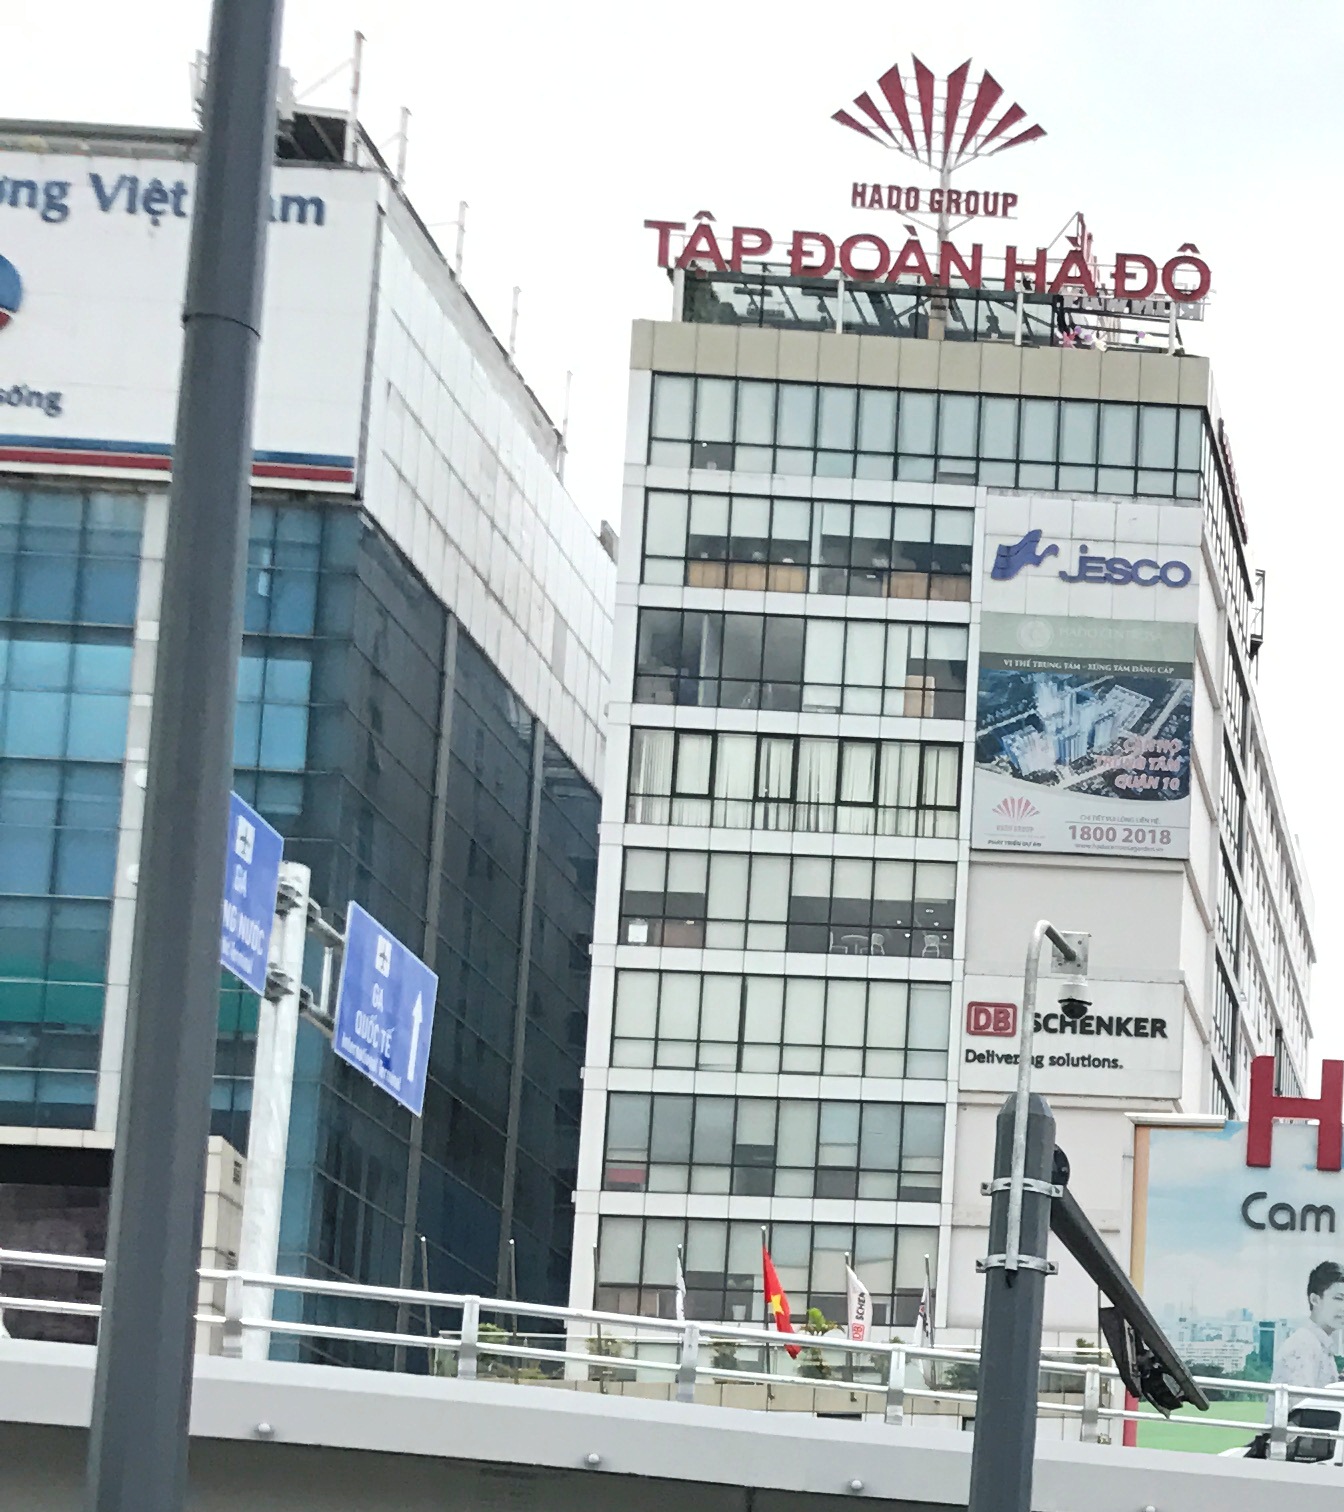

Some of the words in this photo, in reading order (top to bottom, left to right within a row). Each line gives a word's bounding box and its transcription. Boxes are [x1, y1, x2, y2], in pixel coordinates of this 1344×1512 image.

[88, 171, 188, 226] Việt
[851, 182, 920, 213] HADO
[929, 187, 1018, 218] GROUP
[787, 224, 983, 289] ĐOÀN
[1004, 234, 1094, 297] HÀ
[1162, 776, 1180, 791] 10
[1069, 825, 1117, 842] 1800
[1122, 828, 1172, 845] 2018
[972, 1005, 1013, 1033] DB
[1032, 1013, 1168, 1039] SCHENKER
[1048, 1052, 1124, 1070] solutions.
[1241, 1191, 1336, 1234] Cam
